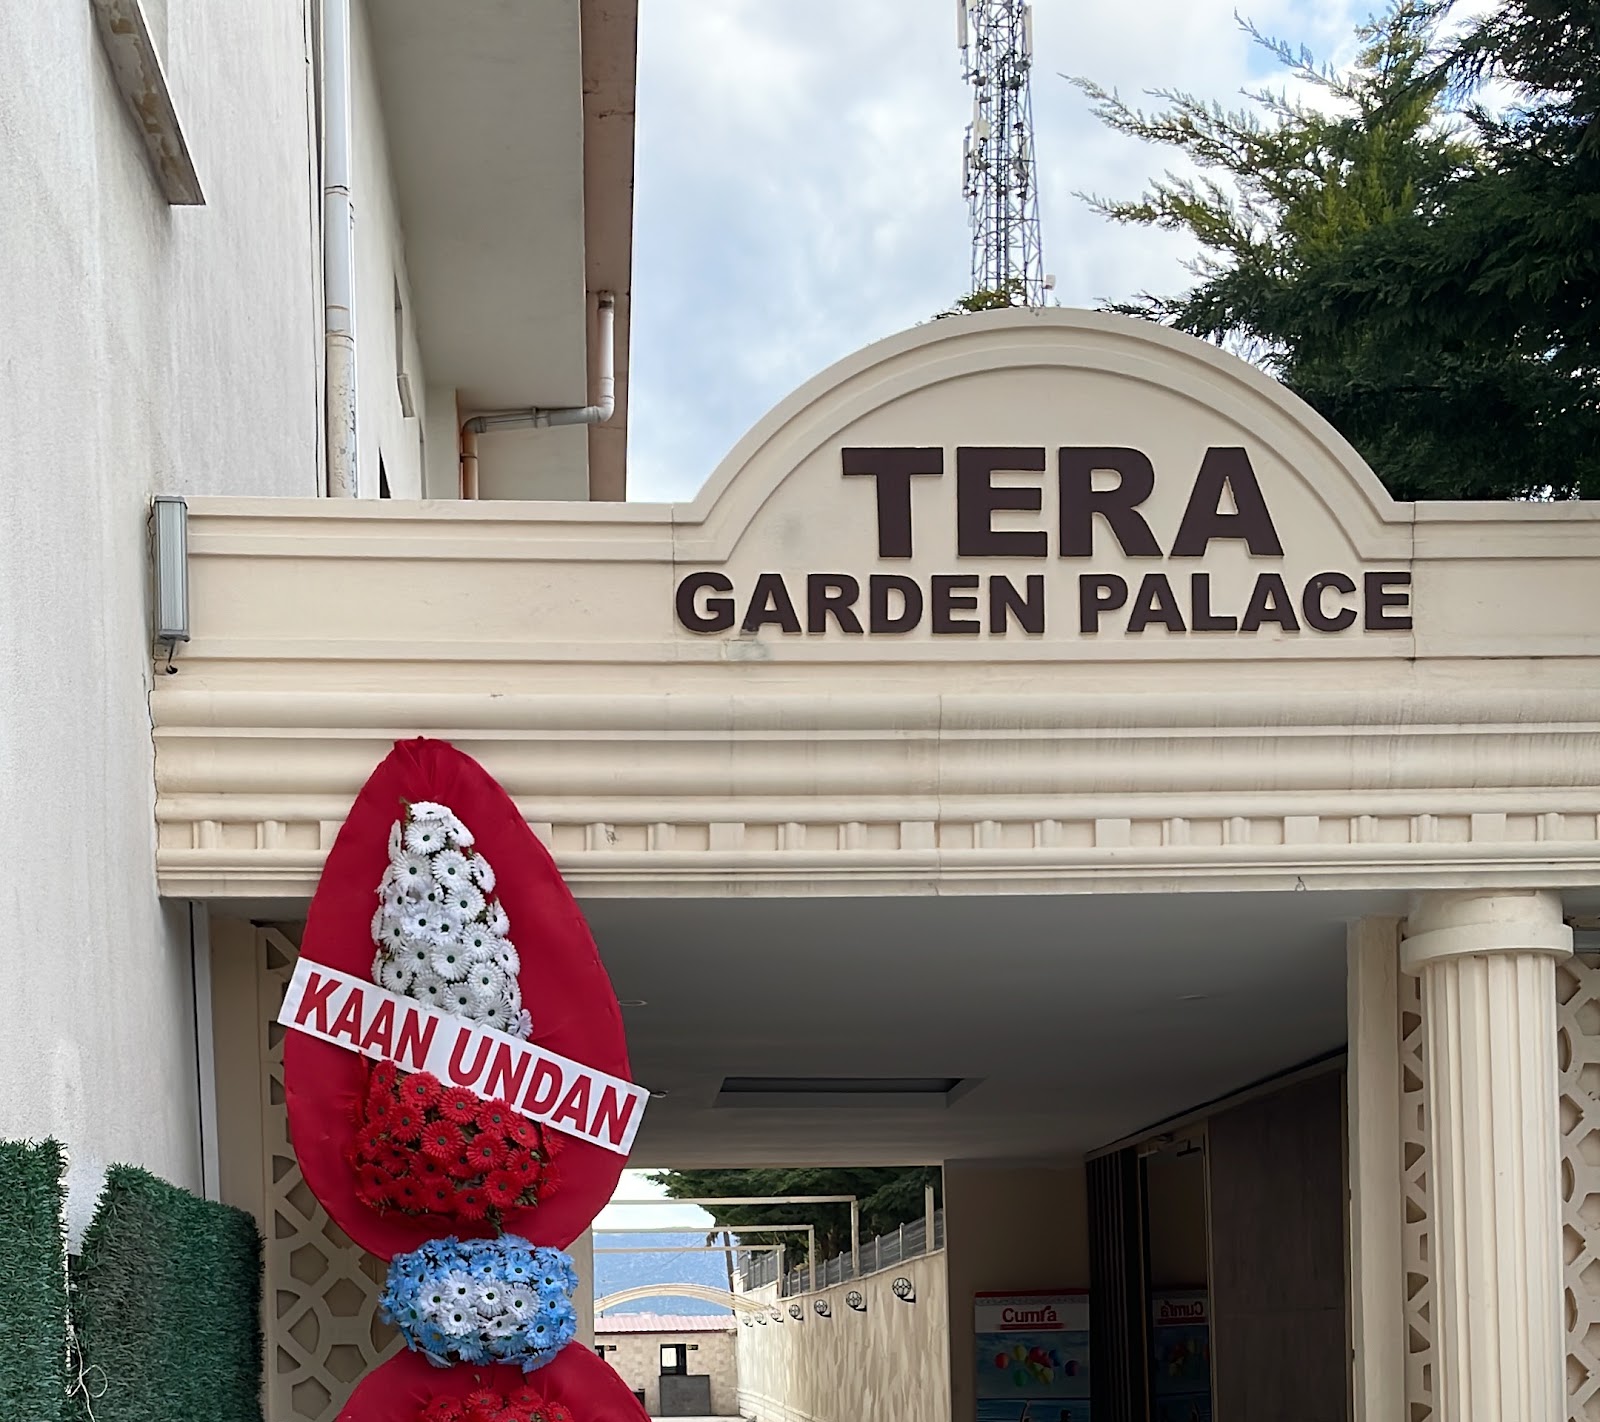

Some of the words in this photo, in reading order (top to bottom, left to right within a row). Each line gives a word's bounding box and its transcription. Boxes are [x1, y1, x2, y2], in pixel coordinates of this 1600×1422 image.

[842, 446, 1284, 557] TERA
[675, 571, 1045, 635] GARDEN
[1079, 571, 1413, 635] PALACE
[295, 972, 438, 1070] KAAN
[447, 1027, 637, 1146] UNDAN
